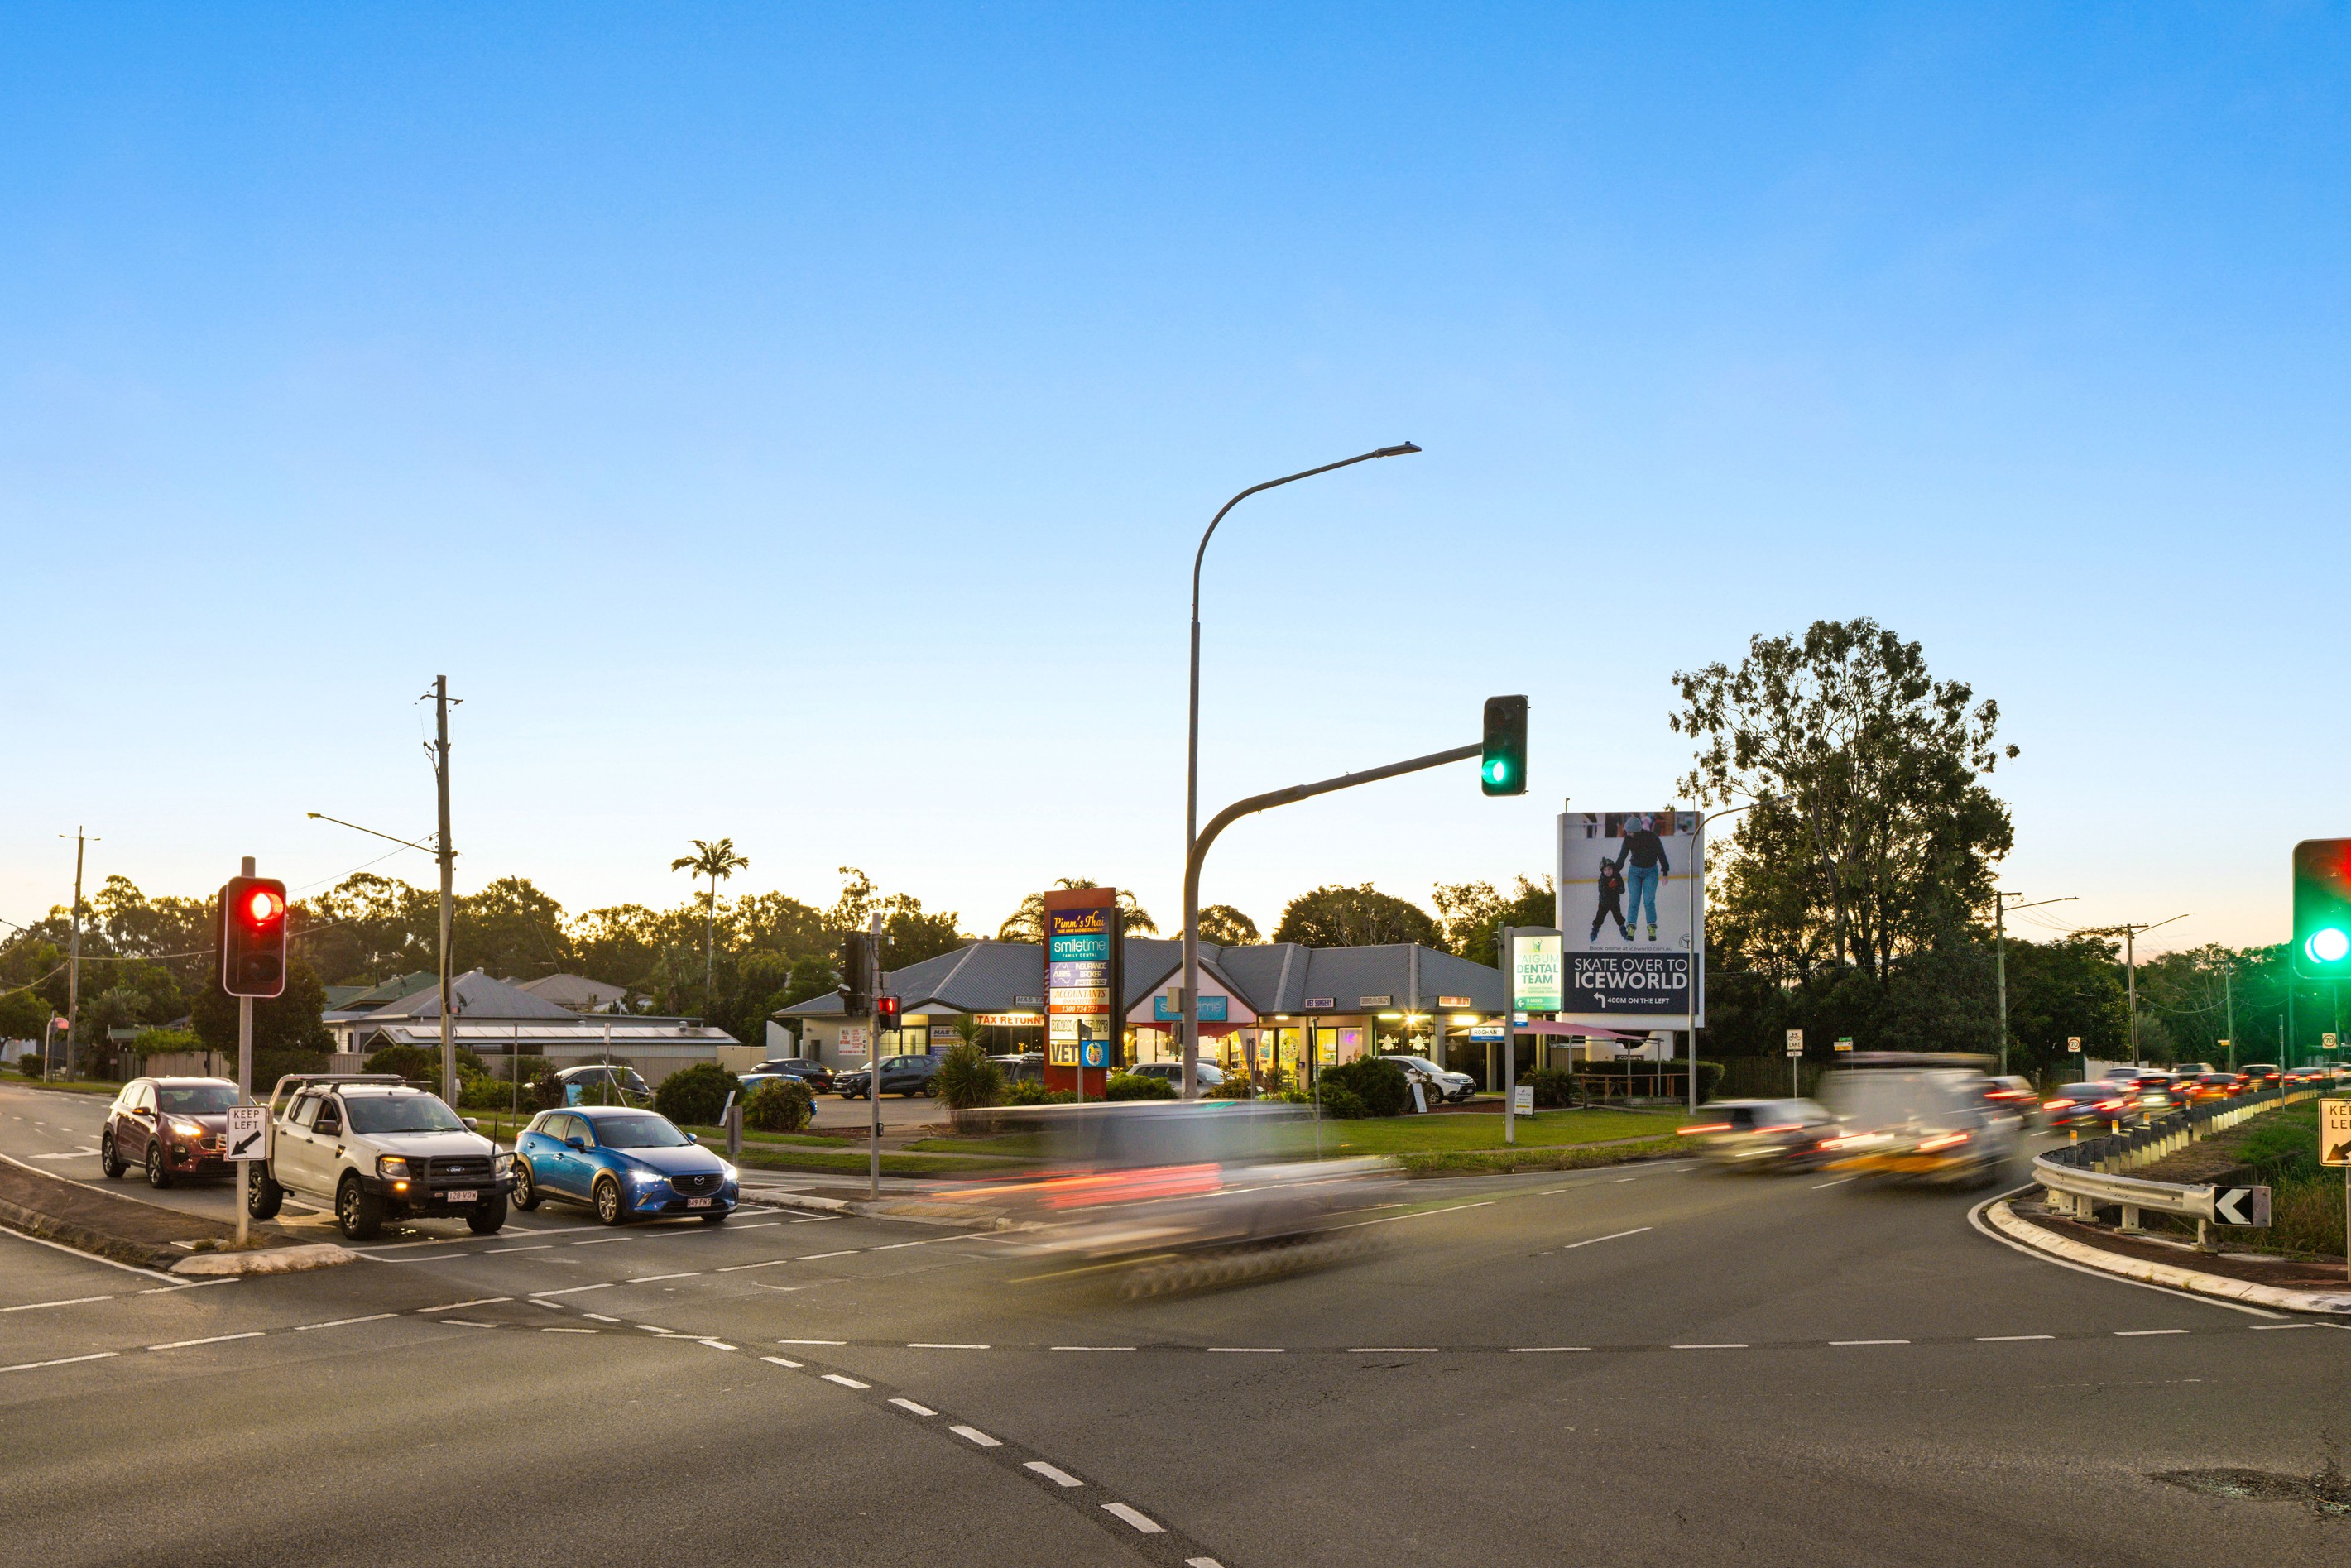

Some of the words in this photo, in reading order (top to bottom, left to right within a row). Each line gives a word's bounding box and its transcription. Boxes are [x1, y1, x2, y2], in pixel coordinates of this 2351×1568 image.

[1054, 915, 1083, 928] Pimm's
[1084, 910, 1106, 928] Thai
[1054, 938, 1106, 952] smiletime
[1517, 954, 1559, 963] TAIGUM
[1517, 964, 1559, 973] DENTAL
[1575, 958, 1617, 971] SKATE
[1622, 958, 1662, 971] OVER
[1667, 959, 1687, 971] TO
[1522, 975, 1553, 984] TEAM
[1576, 972, 1687, 989] ICEWORLD
[1054, 990, 1106, 998] ACCOUNTANTS
[977, 1015, 996, 1024] TAX
[1050, 1044, 1078, 1062] VET
[234, 1110, 260, 1118] KEEP
[2329, 1105, 2351, 1115] KE
[235, 1121, 258, 1129] LEFT
[2331, 1119, 2351, 1129] LE
